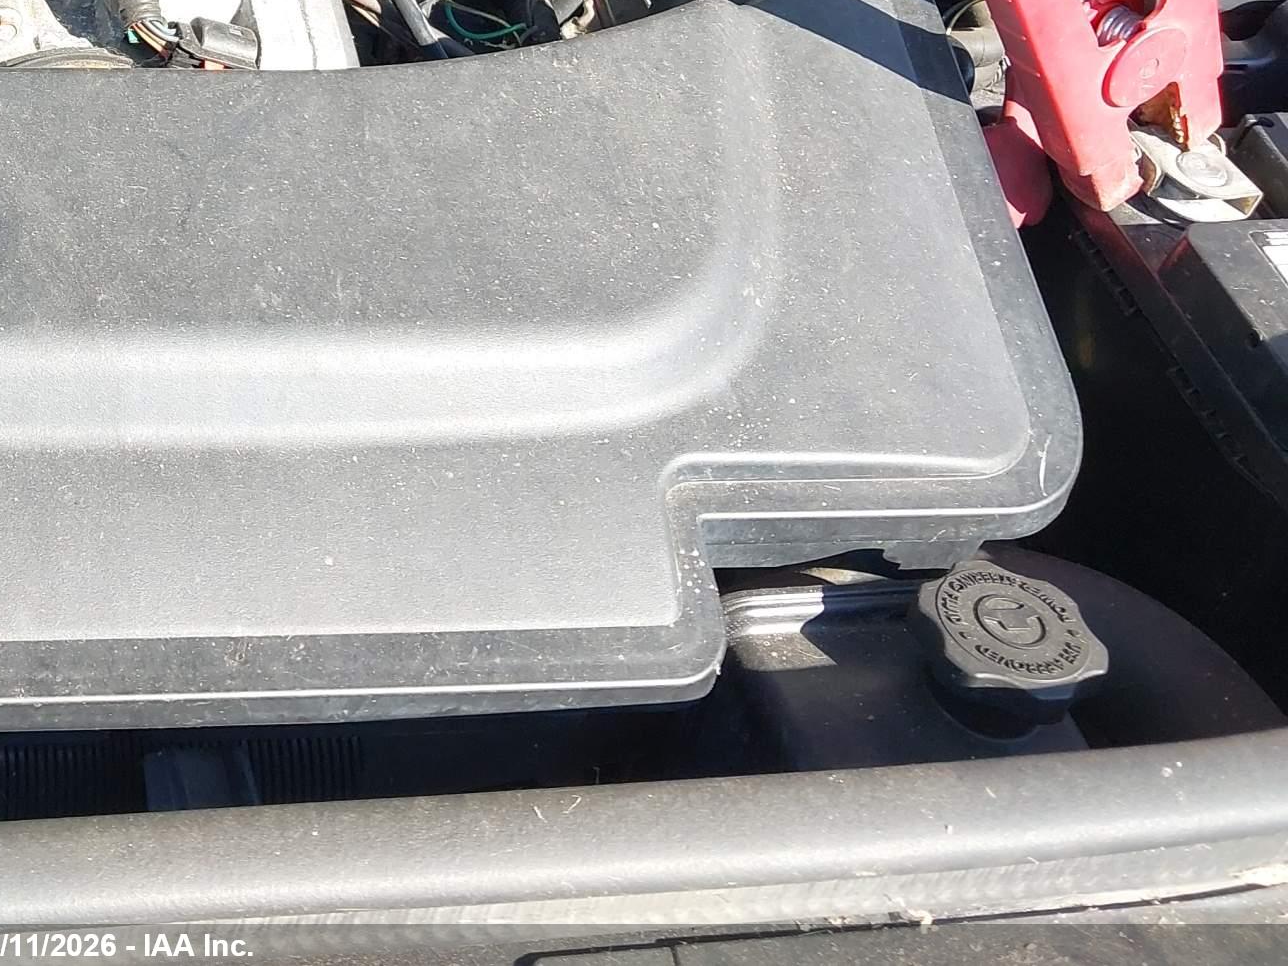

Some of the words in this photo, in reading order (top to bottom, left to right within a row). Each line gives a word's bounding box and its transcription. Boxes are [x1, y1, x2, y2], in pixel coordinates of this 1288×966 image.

[949, 570, 1016, 592] STEERING
[940, 590, 962, 626] FLUID
[1019, 582, 1071, 622] POWER
[974, 644, 1063, 675] APPROVED
[1057, 641, 1081, 666] USE
